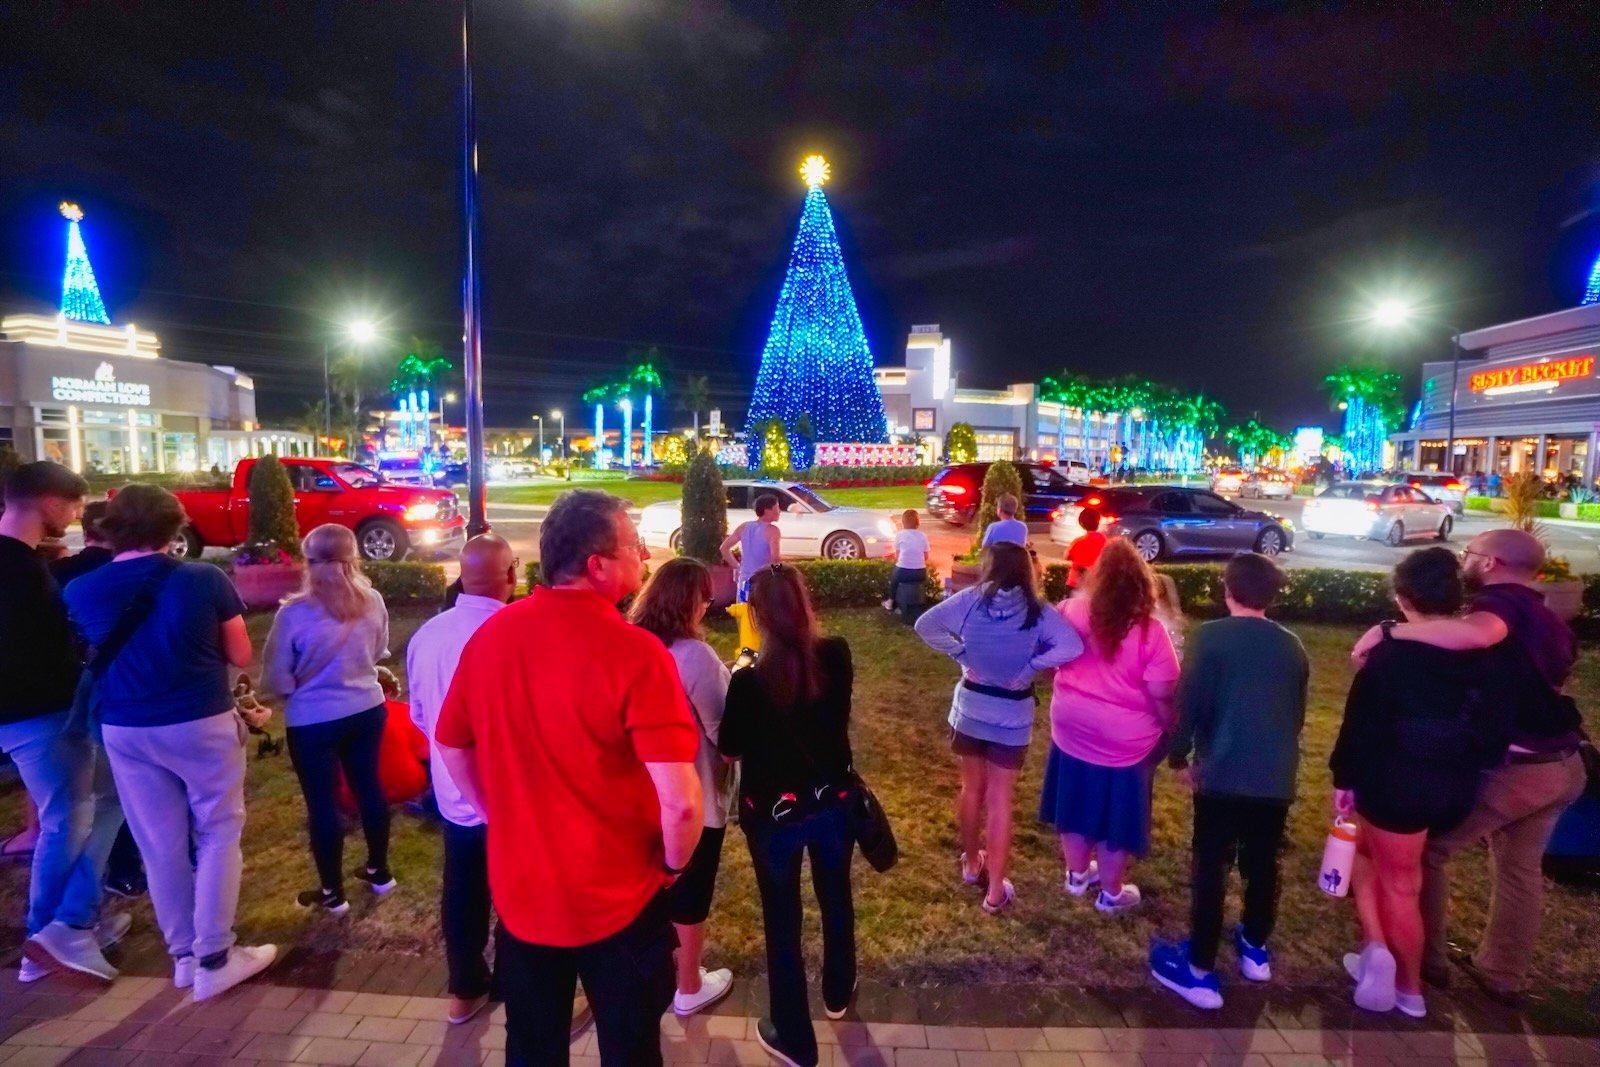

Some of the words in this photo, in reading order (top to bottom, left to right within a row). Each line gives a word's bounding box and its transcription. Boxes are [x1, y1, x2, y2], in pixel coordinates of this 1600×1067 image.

[1519, 357, 1595, 383] BUCKET
[52, 376, 116, 392] NORMAN
[118, 382, 150, 395] LOVE
[53, 388, 151, 405] CONFECTIONS
